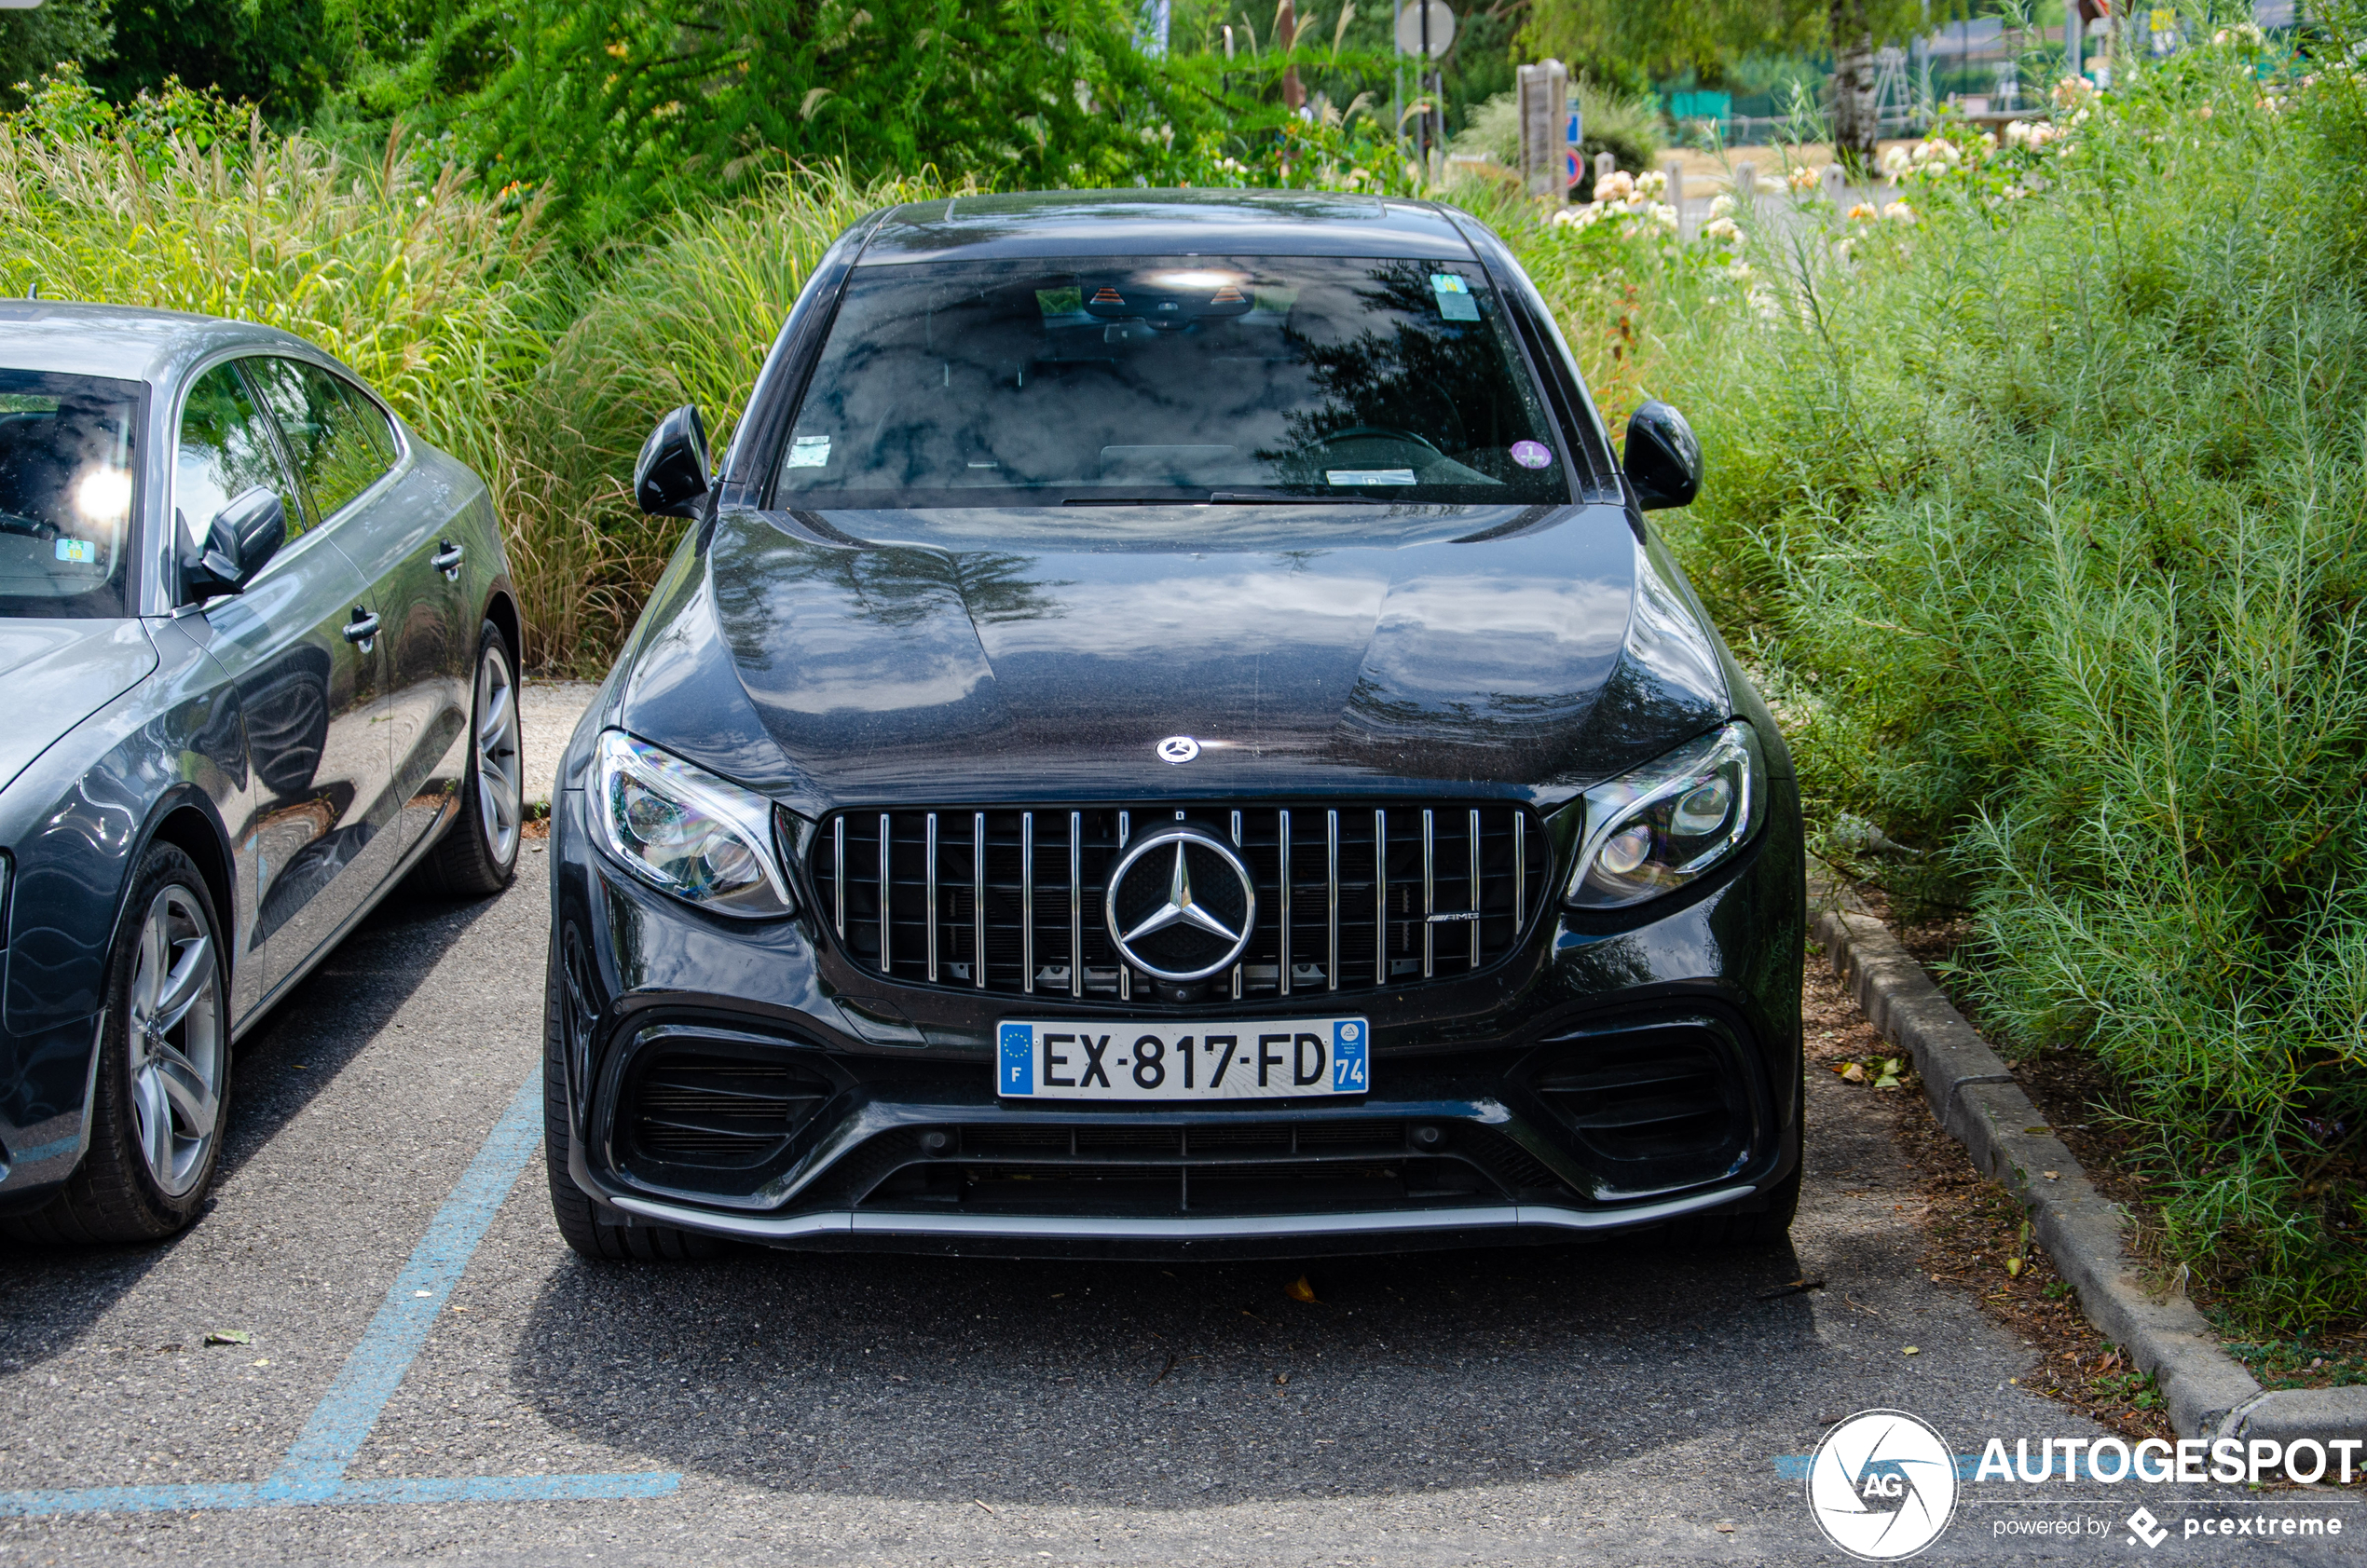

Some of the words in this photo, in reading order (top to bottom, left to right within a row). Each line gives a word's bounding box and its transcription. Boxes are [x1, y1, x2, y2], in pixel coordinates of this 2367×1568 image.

[1526, 445, 1534, 456] 1
[67, 549, 83, 559] 19
[1043, 1032, 1326, 1089] EX-817-FD
[1011, 1067, 1021, 1082] F
[1335, 1058, 1363, 1084] 74
